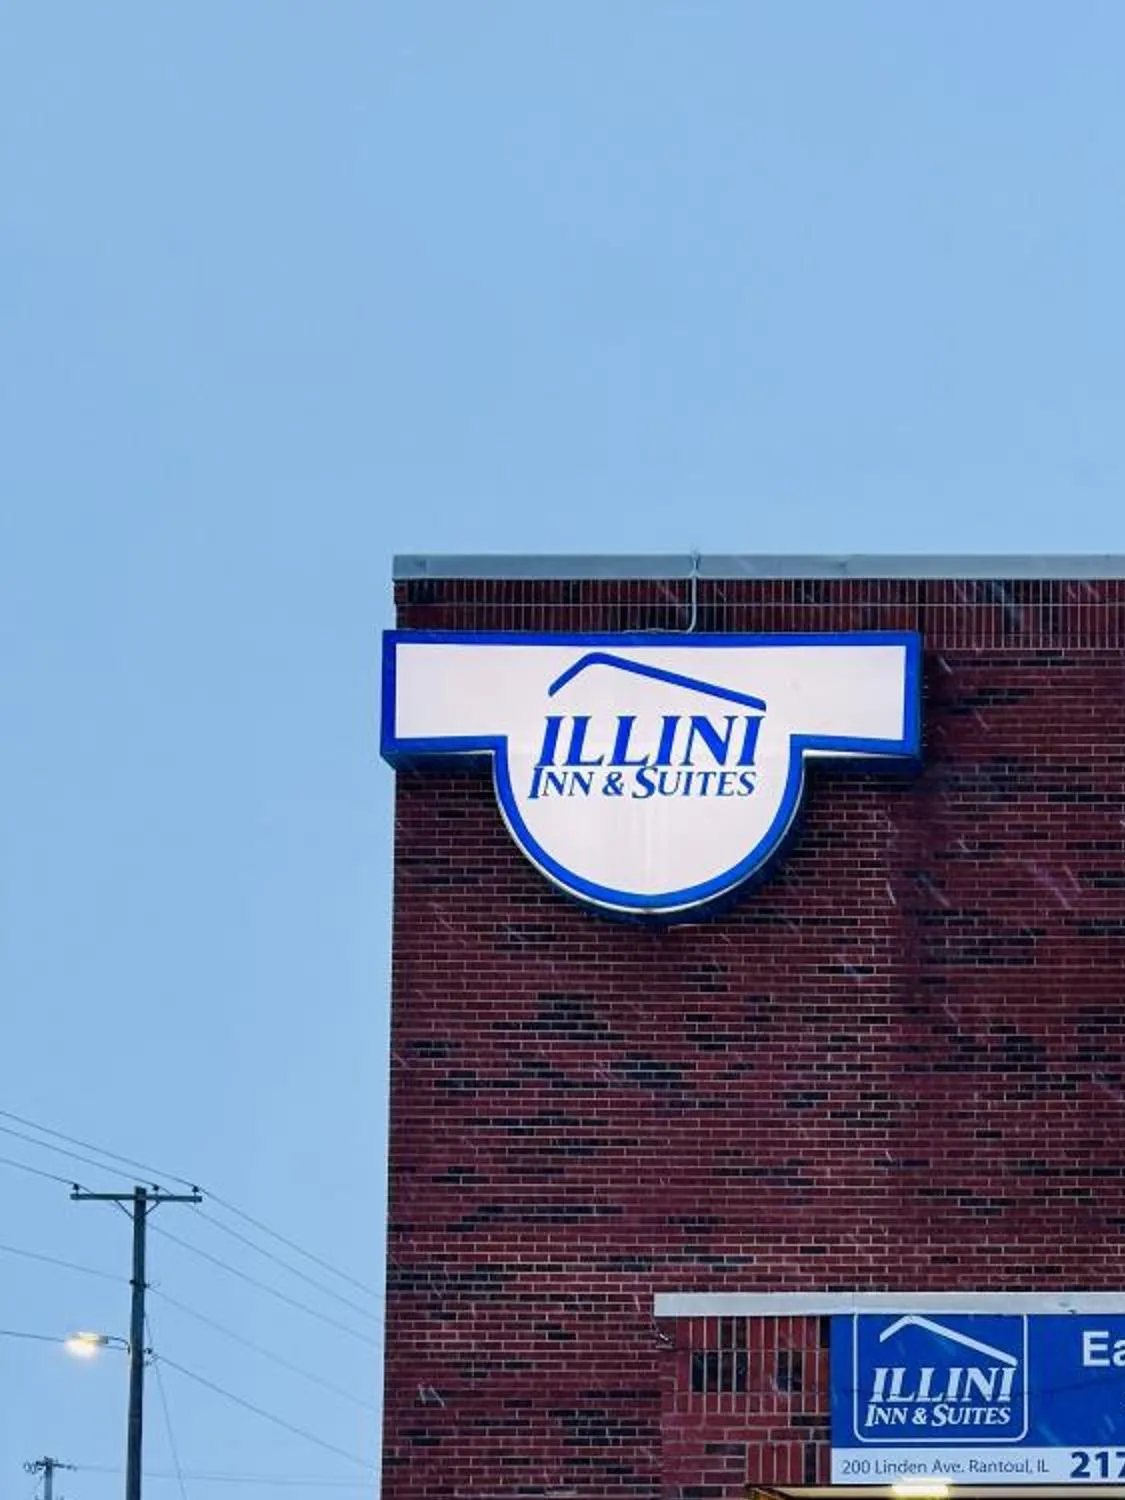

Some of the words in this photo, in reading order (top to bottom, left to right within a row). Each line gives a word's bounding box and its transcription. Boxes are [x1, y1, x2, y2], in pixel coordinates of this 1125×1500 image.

[535, 715, 766, 767] ILLINI
[528, 767, 594, 799] INN
[602, 771, 625, 797] &
[631, 766, 757, 799] SUITES
[869, 1367, 1018, 1403] ILLINI
[864, 1403, 909, 1427] INN
[911, 1407, 928, 1425] &
[931, 1403, 1012, 1427] SUITES
[841, 1459, 871, 1475] 200
[875, 1458, 928, 1475] Linden
[931, 1459, 965, 1474] Ave.
[969, 1458, 1033, 1475] Rantoul,
[1037, 1459, 1049, 1473] IL
